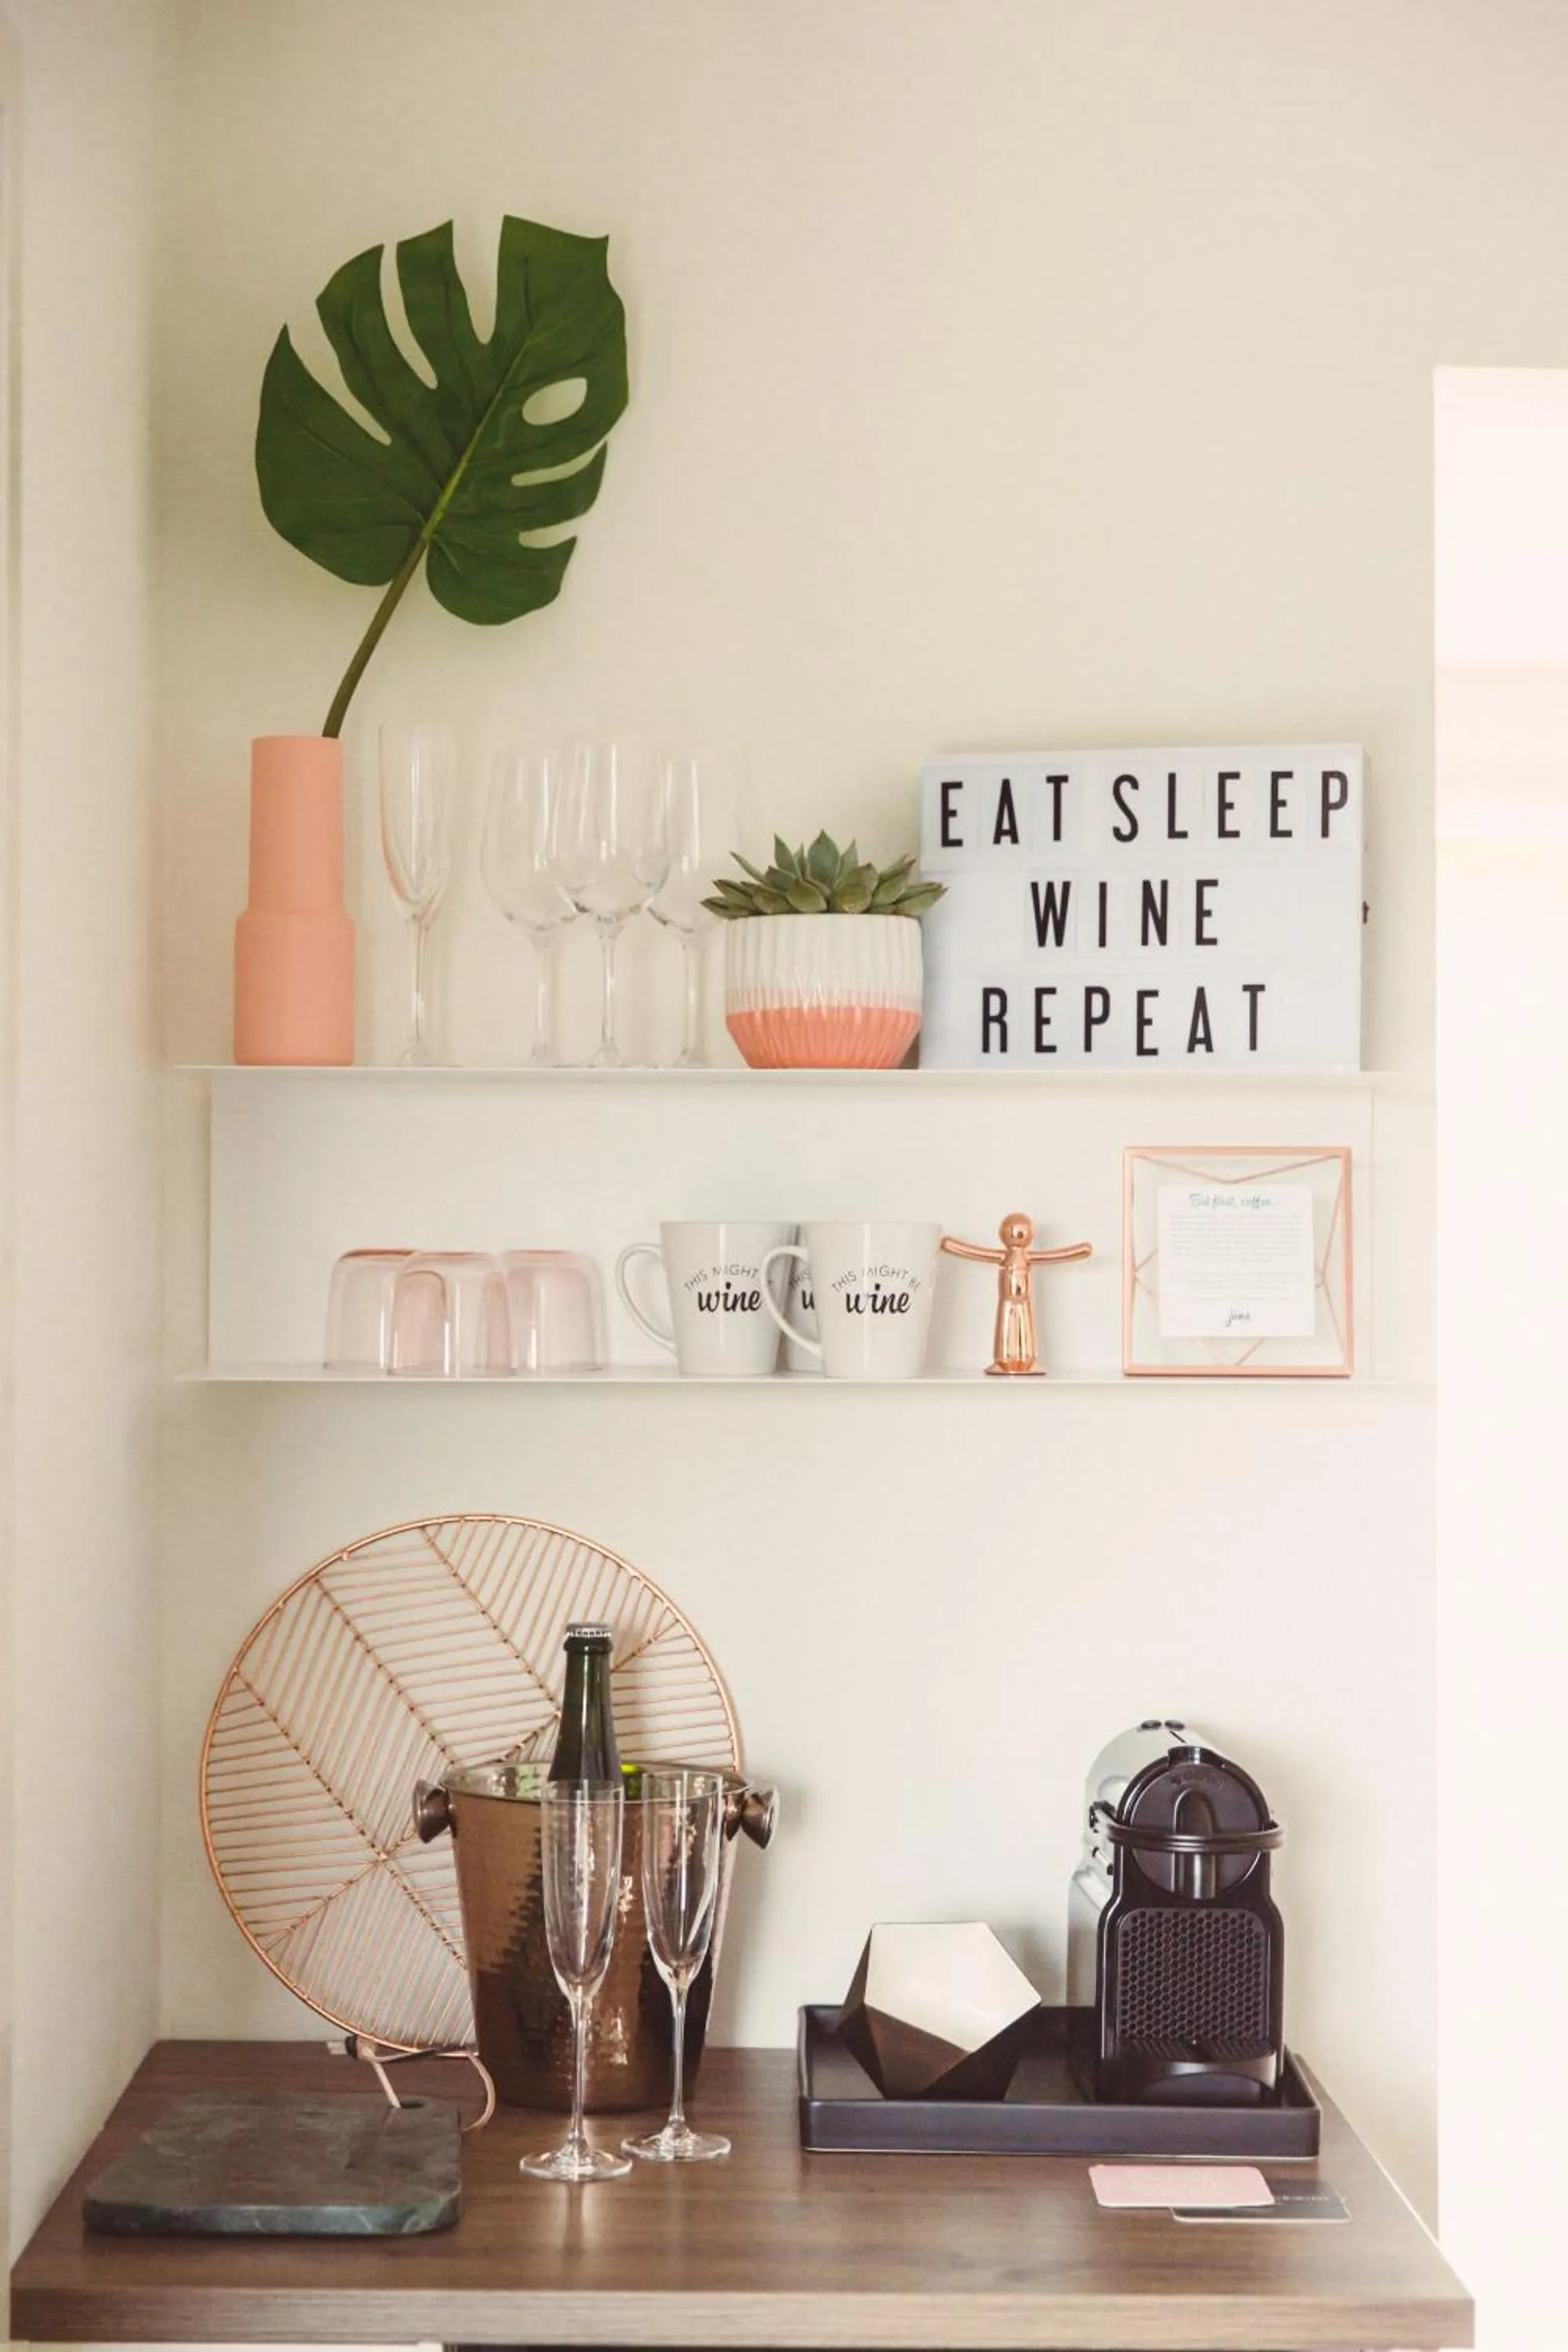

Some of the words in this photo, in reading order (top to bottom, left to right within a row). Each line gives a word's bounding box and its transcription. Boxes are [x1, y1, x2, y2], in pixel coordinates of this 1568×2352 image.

[941, 774, 1069, 848] EAT
[1112, 770, 1348, 843] SLEEP
[1031, 879, 1219, 948] WINE
[982, 984, 1266, 1056] REPEAT
[683, 1269, 708, 1293] THIS
[831, 1270, 858, 1293] THIS
[862, 1264, 909, 1280] MIGHT
[697, 1281, 763, 1312] wine
[845, 1283, 912, 1315] wine
